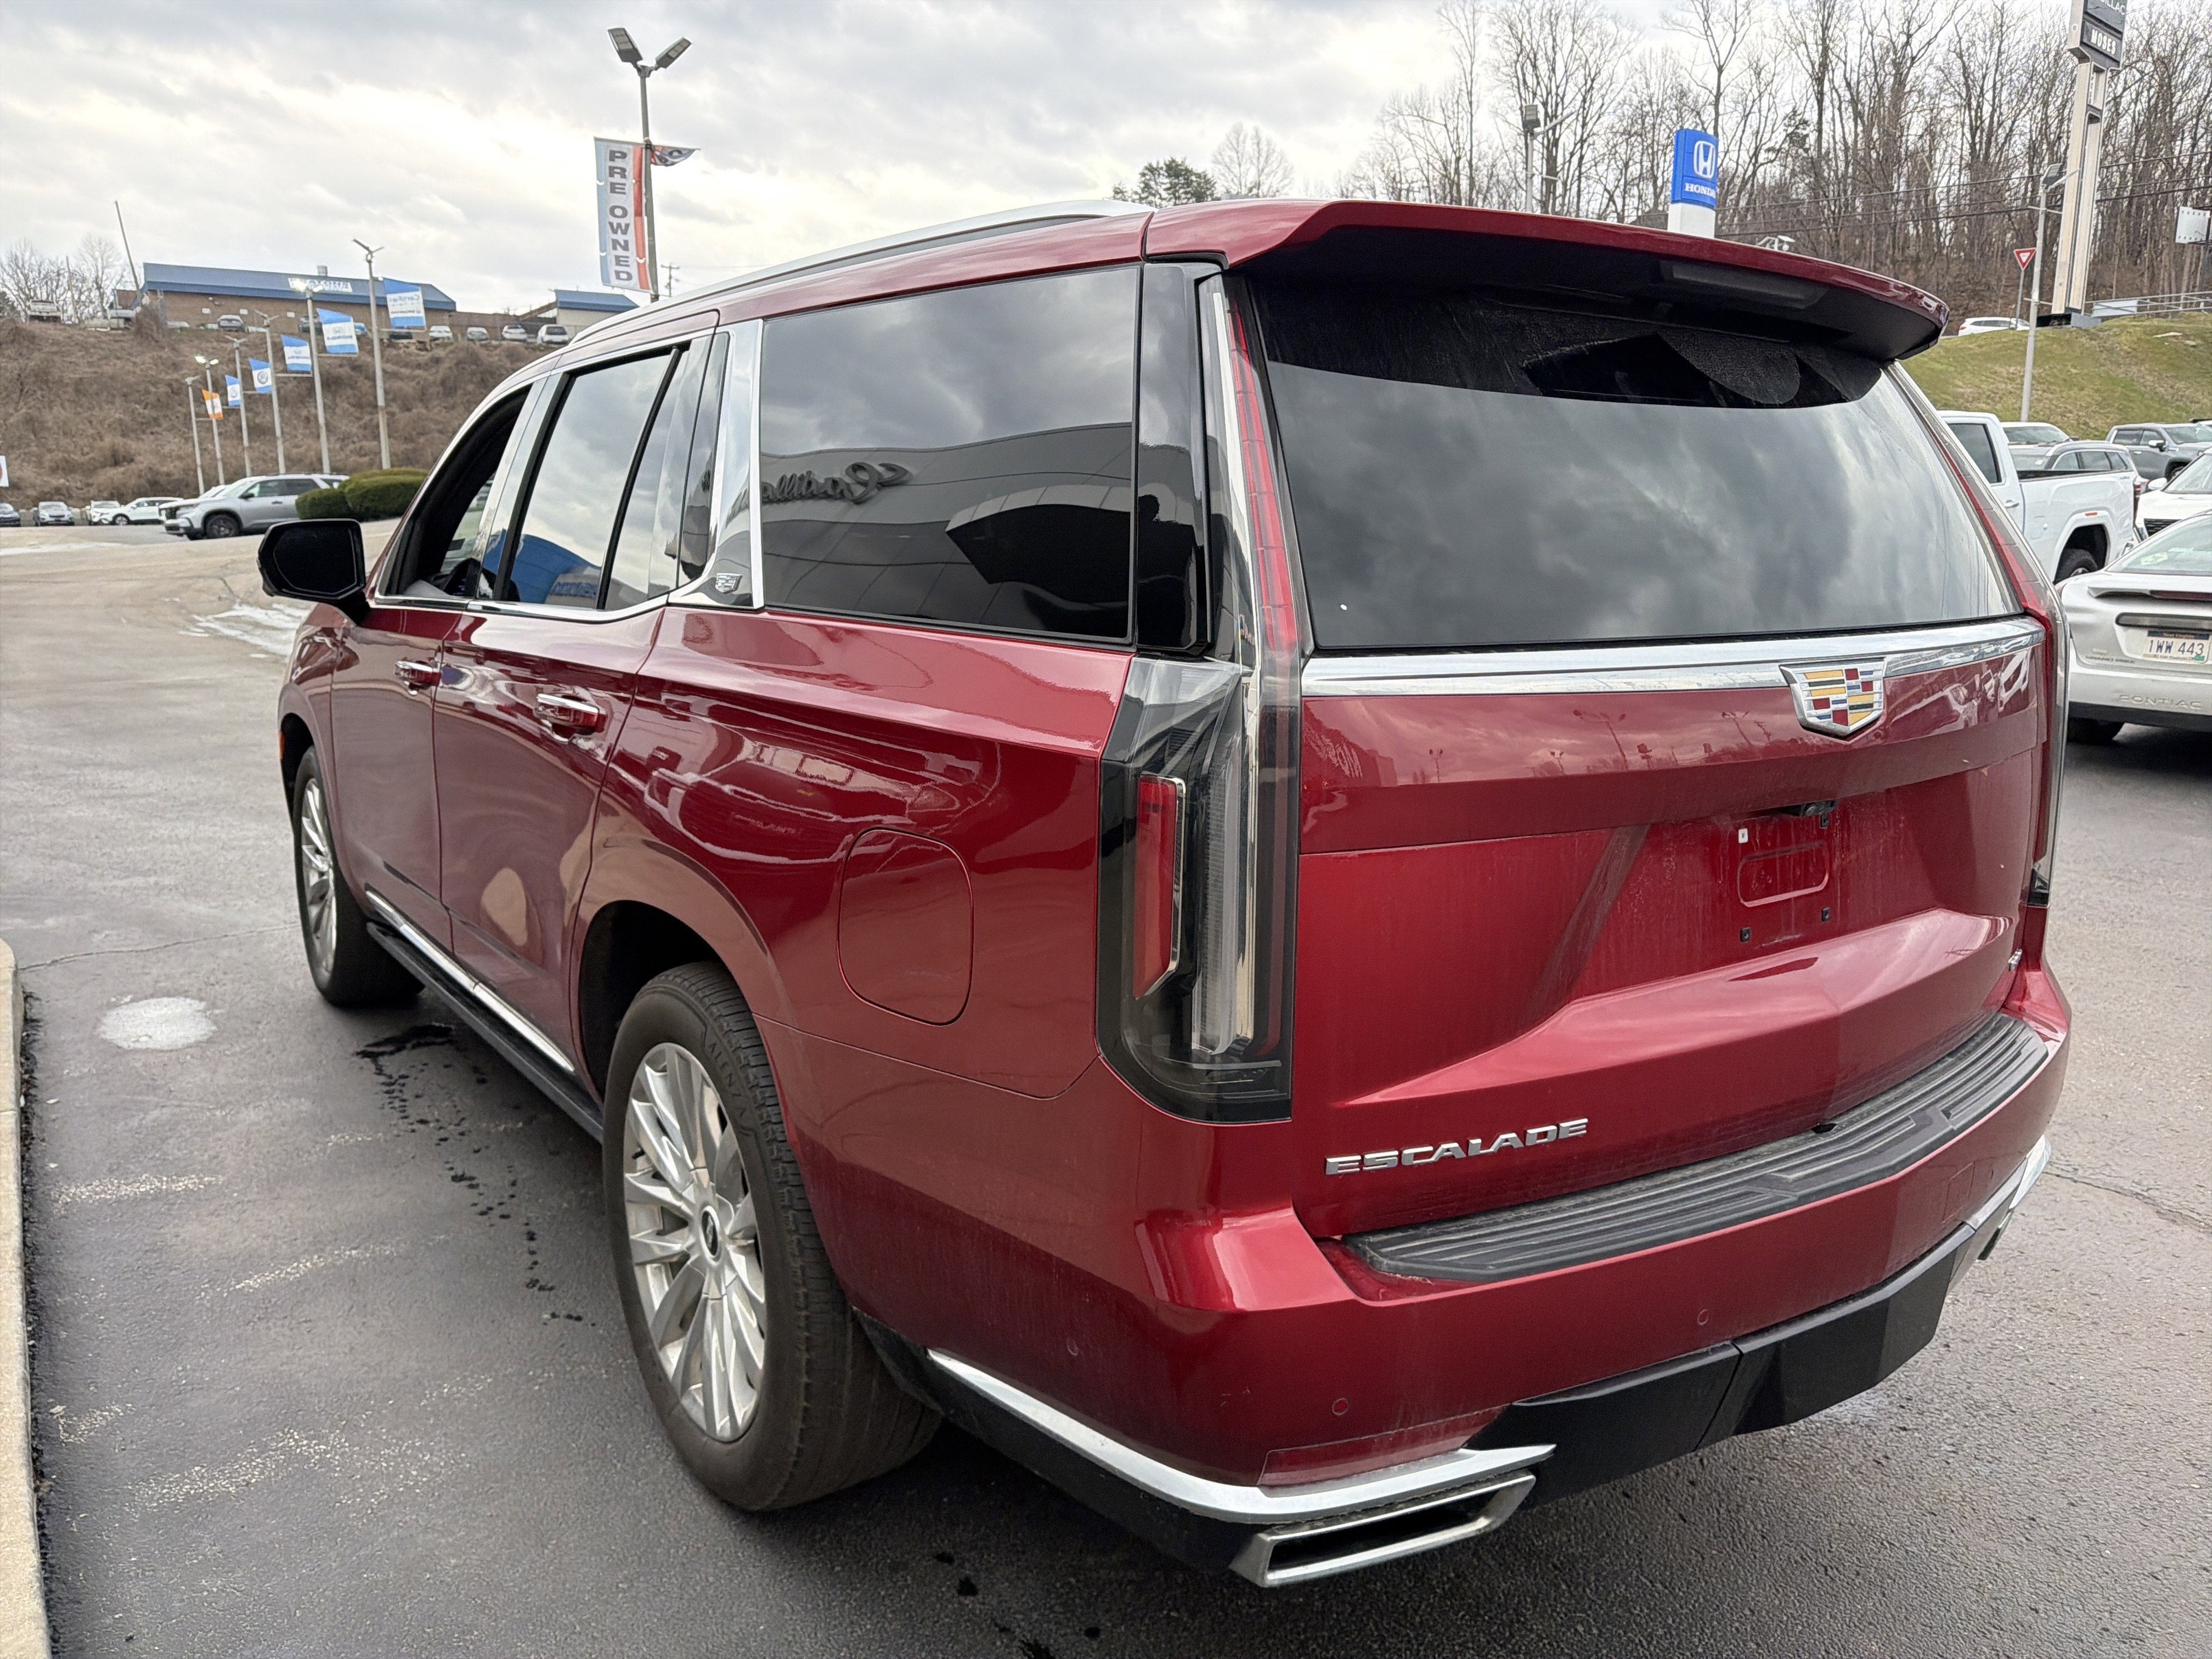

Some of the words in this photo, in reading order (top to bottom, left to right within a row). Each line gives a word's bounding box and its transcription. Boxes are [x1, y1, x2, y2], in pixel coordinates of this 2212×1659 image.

[2091, 29, 2116, 54] MOSES
[608, 150, 627, 195] PRE
[608, 205, 633, 281] OWNED
[2177, 641, 2204, 656] 443
[2119, 694, 2202, 710] PONTIAC
[1325, 1118, 1589, 1176] ESCALADE
